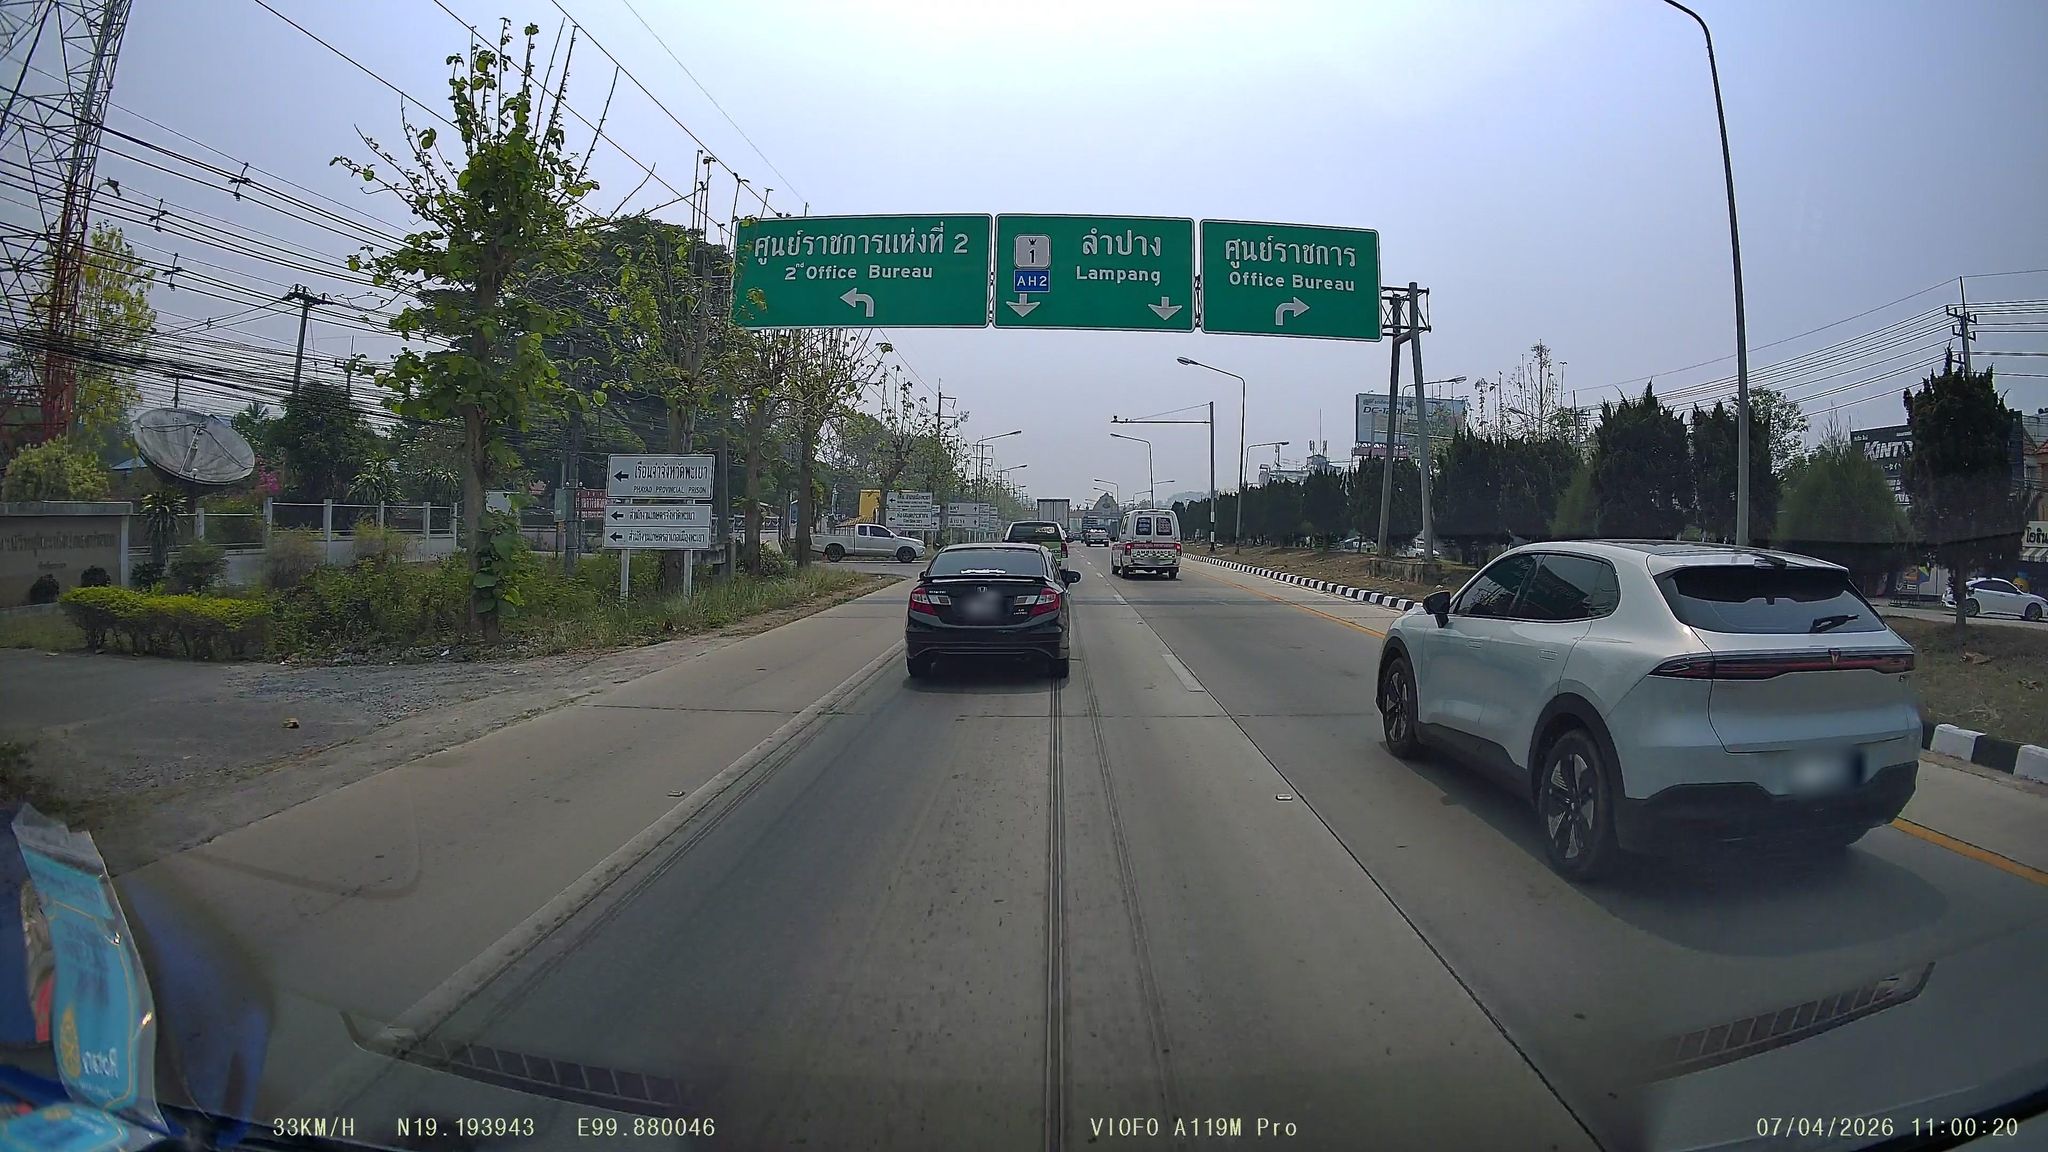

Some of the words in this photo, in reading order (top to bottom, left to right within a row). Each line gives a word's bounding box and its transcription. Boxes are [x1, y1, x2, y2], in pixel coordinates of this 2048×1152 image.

[754, 221, 944, 264] ศูนย์ราชการแห่งที่
[953, 233, 969, 254] 2
[1082, 228, 1161, 257] ลำปาง
[1225, 234, 1356, 269] ศูนย์ราชการ
[1028, 249, 1036, 264] 1
[806, 264, 857, 279] Office
[869, 265, 933, 279] Bureau
[1017, 275, 1048, 287] AH2
[1076, 265, 1161, 285] Lampang
[1229, 272, 1284, 288] Office
[1292, 274, 1355, 291] Bureau
